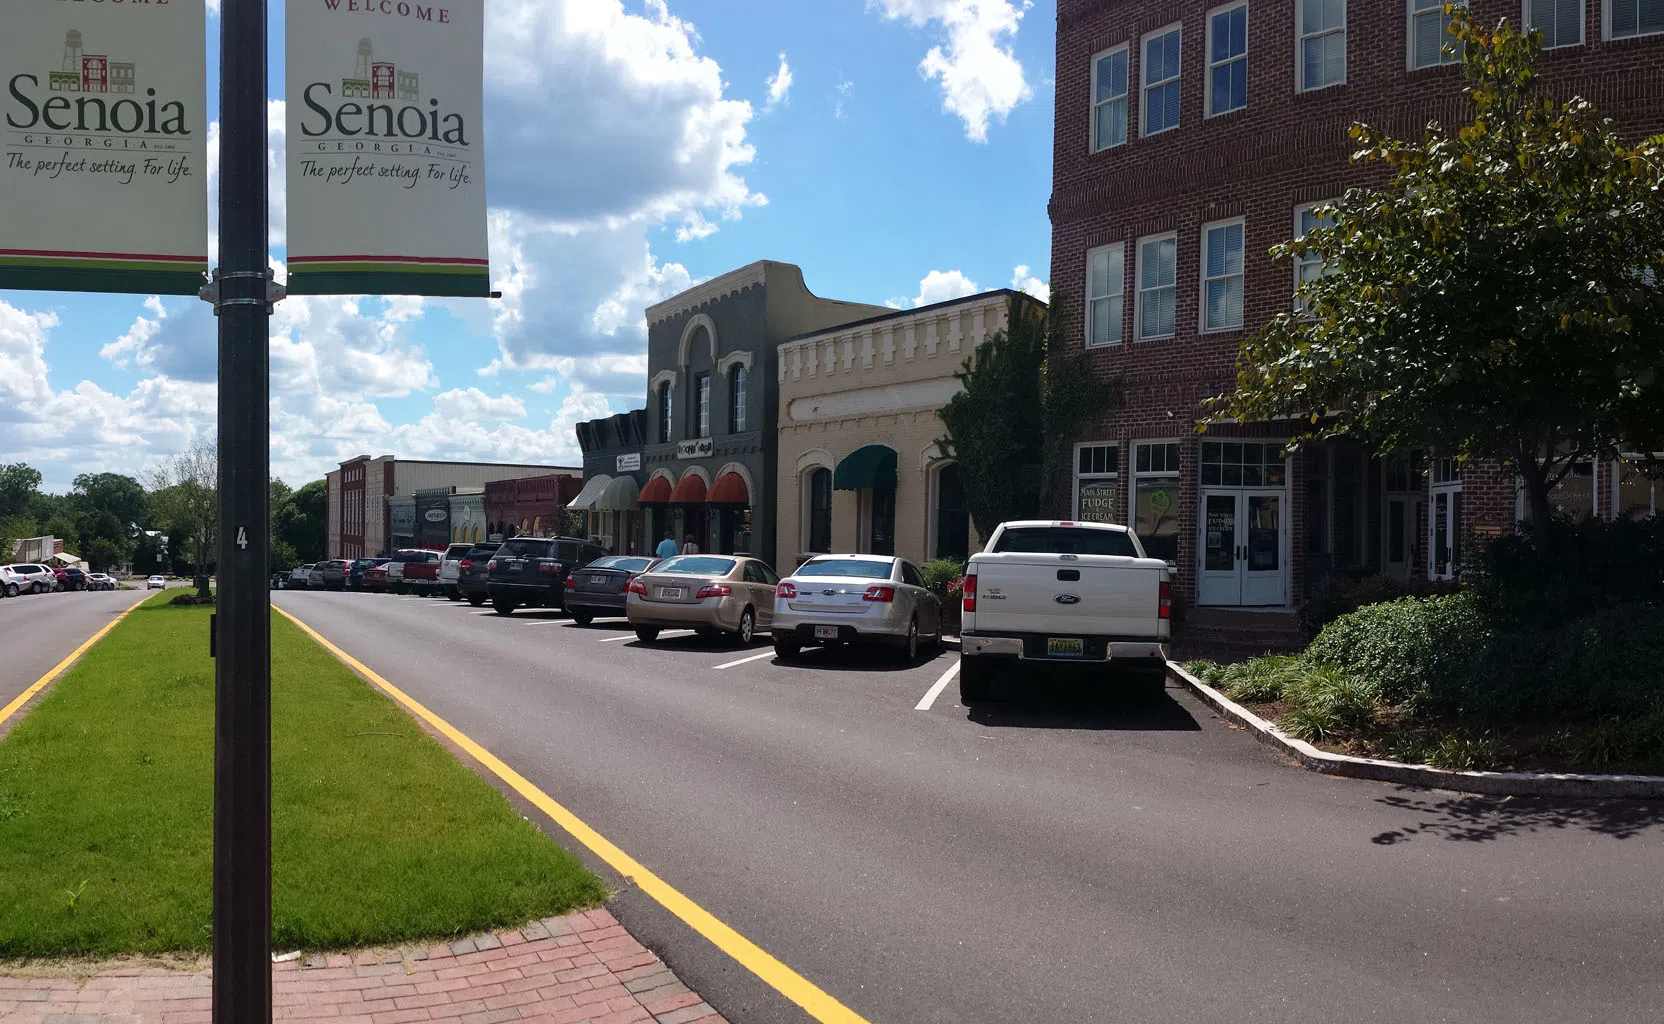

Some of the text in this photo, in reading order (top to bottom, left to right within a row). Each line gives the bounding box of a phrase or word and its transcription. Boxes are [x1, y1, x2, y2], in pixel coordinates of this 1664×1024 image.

[324, 0, 451, 23] WELCOME
[6, 73, 192, 135] Senoia
[301, 82, 470, 146] Senoia
[6, 151, 193, 184] The perfect setting. For life.
[300, 155, 473, 189] The perfect setting. For life.
[1081, 513, 1114, 521] ICE CREAM
[1082, 498, 1114, 510] FUDGE
[236, 526, 248, 550] 4
